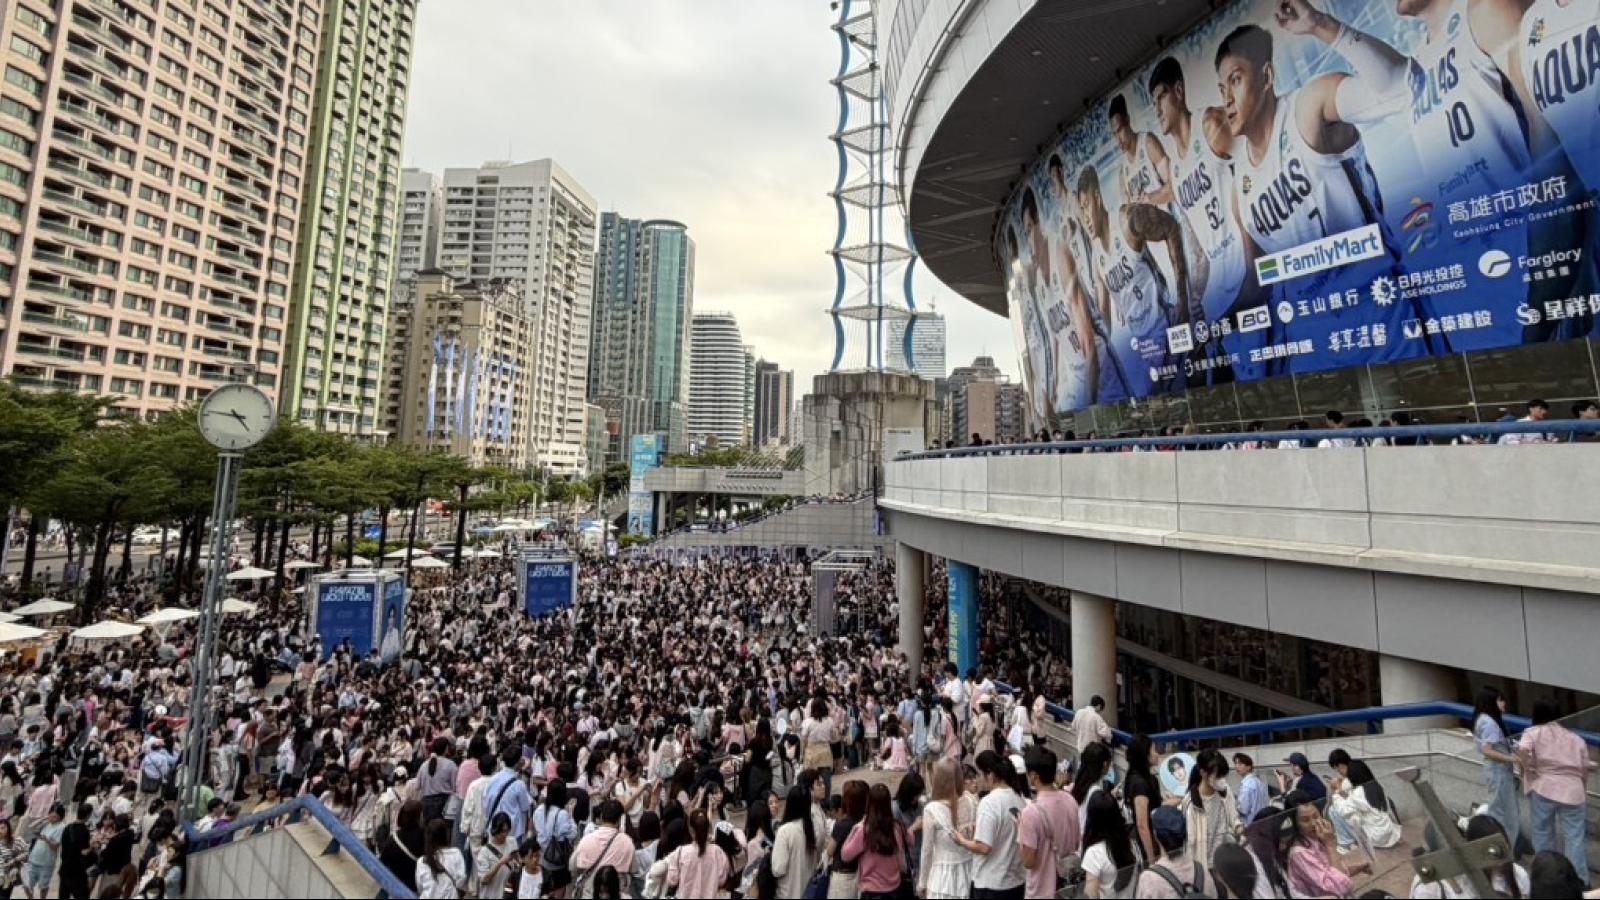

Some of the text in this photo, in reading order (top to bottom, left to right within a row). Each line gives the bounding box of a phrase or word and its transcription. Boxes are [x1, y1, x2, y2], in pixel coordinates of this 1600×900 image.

[1445, 101, 1475, 148] 10
[1177, 162, 1212, 209] AQUAS
[1251, 158, 1312, 236] AQUAS
[1447, 175, 1568, 224] 高雄市政府
[1205, 196, 1224, 230] 52
[1308, 206, 1327, 238] 7
[1504, 217, 1524, 232] City
[1528, 200, 1595, 222] Government
[1282, 232, 1379, 274] FamilyMart
[1517, 247, 1582, 269] Farglory
